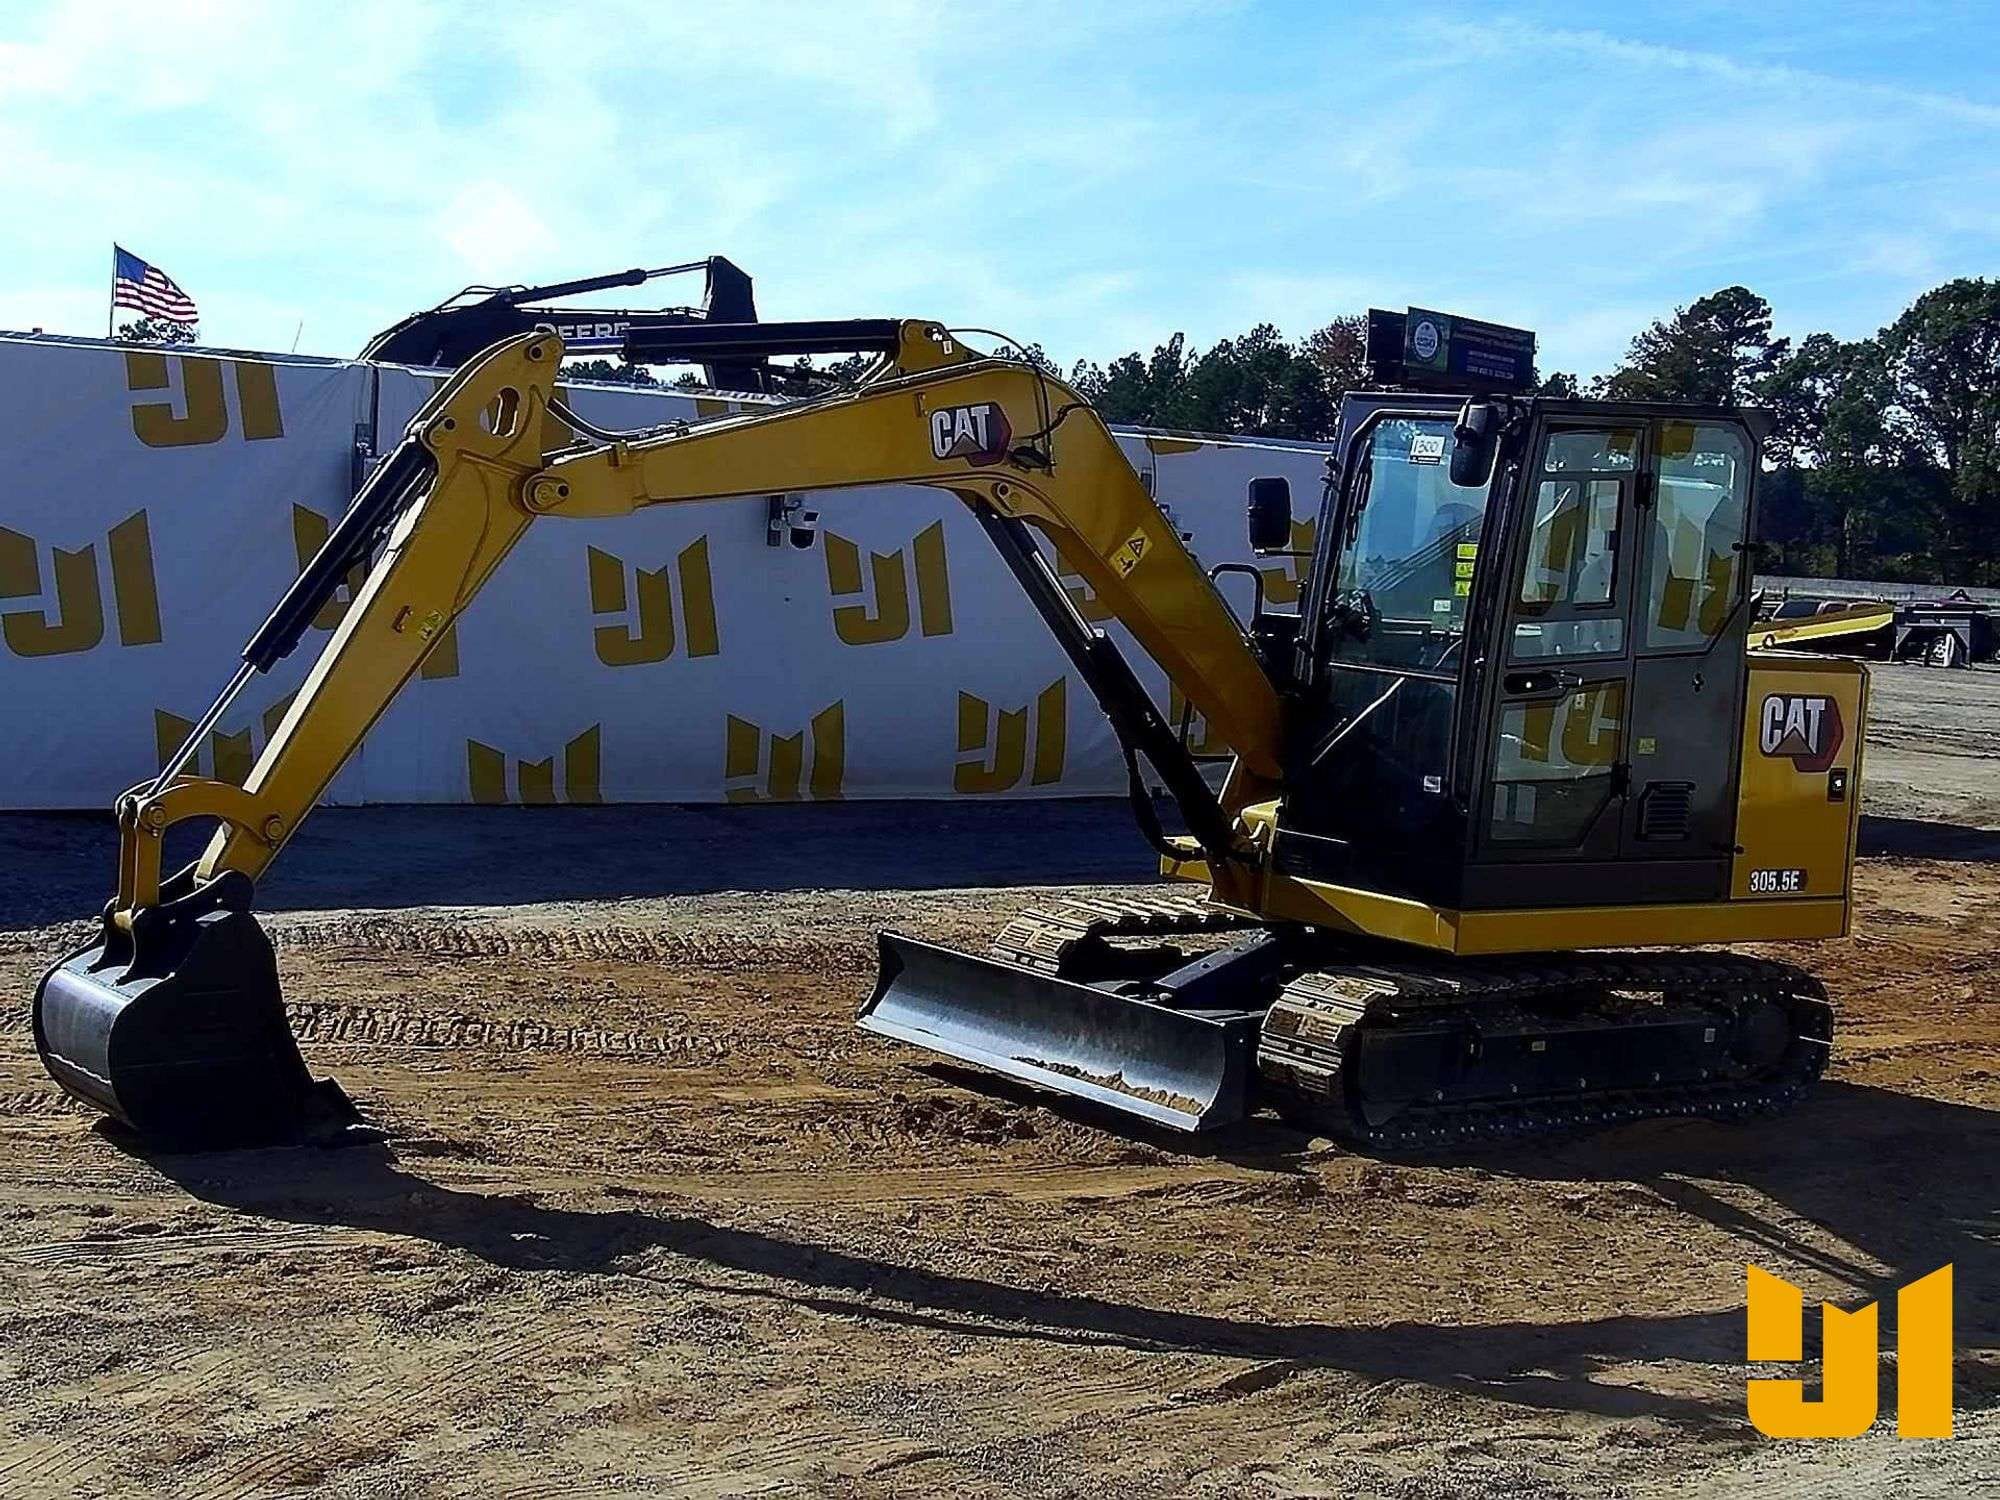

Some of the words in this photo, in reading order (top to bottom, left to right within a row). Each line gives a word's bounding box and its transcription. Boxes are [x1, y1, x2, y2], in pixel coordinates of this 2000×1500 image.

[931, 404, 991, 459] CAT
[1761, 695, 1826, 755] CAT
[1749, 870, 1801, 893] 305.5E
